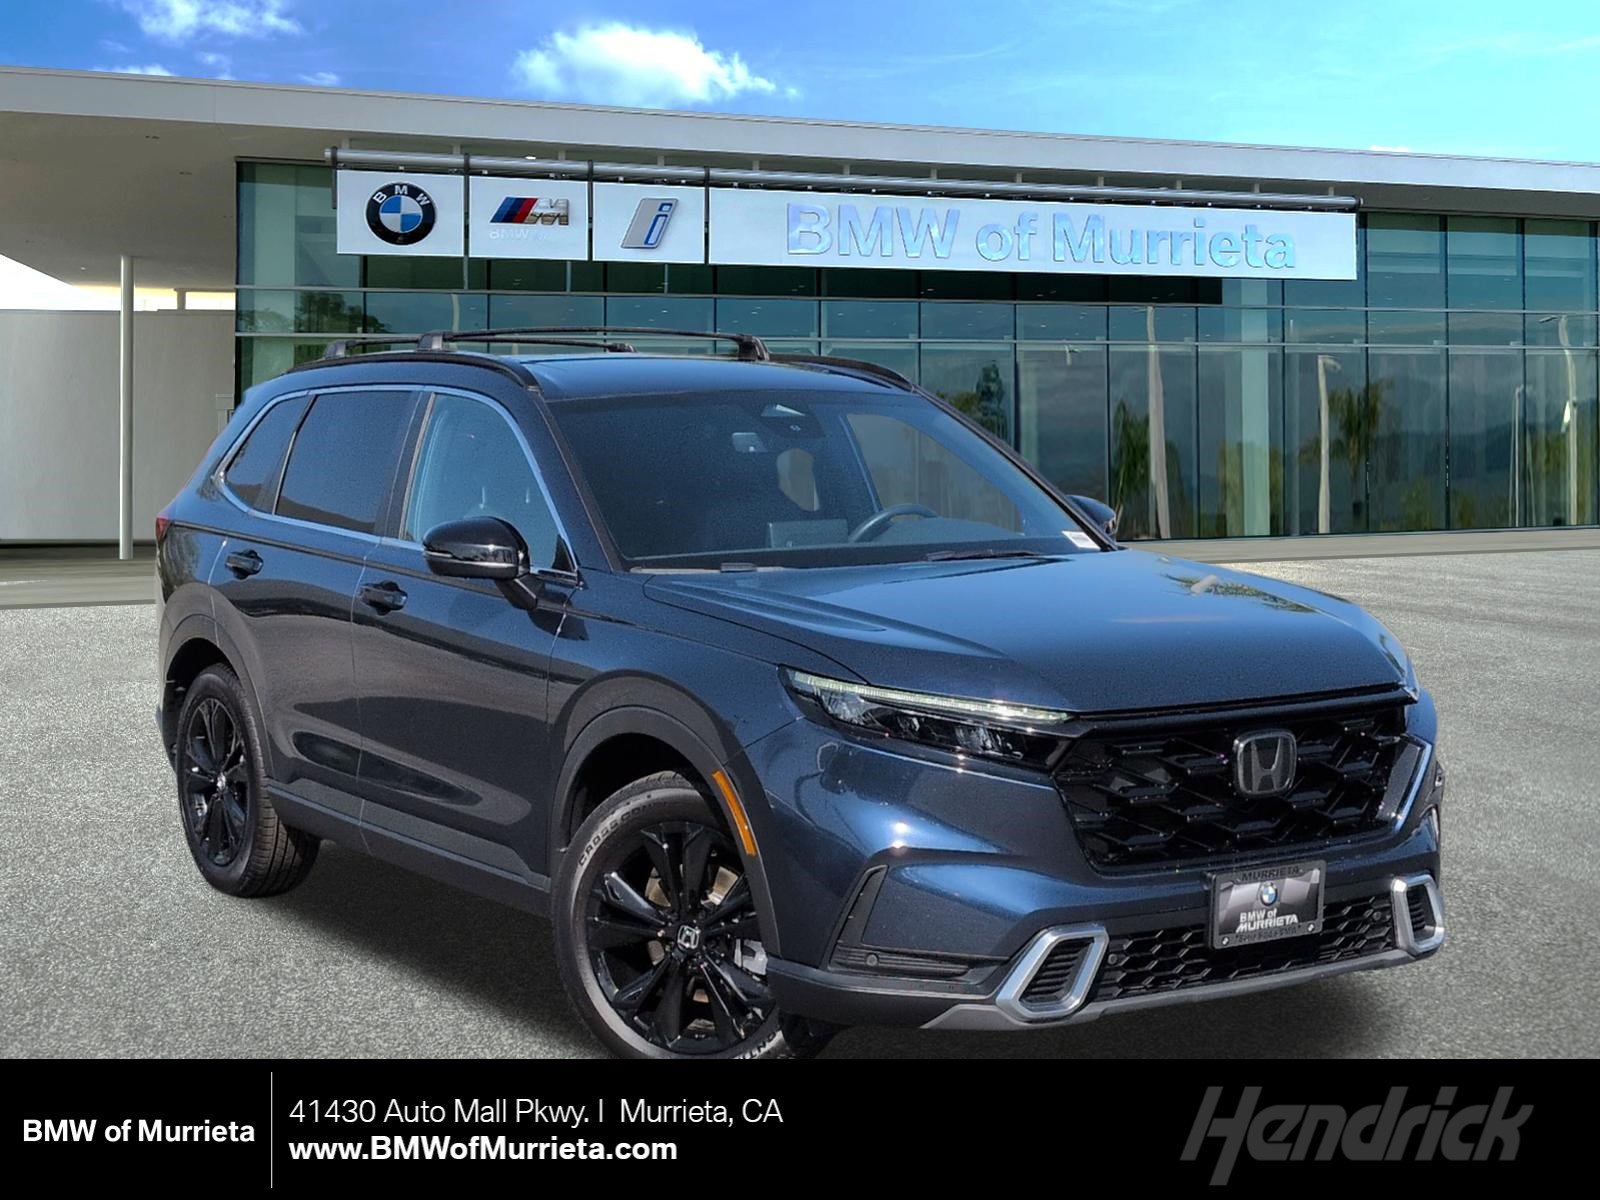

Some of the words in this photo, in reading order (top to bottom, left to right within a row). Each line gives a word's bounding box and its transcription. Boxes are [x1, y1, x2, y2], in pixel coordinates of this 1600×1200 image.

[373, 185, 430, 206] BMW
[786, 201, 962, 259] BMW
[975, 212, 1039, 263] of
[1052, 212, 1297, 270] Murrieta
[1241, 865, 1300, 881] MURRIETA
[1235, 913, 1299, 934] MURRIETA
[1239, 909, 1265, 923] BMW
[1266, 907, 1277, 919] of
